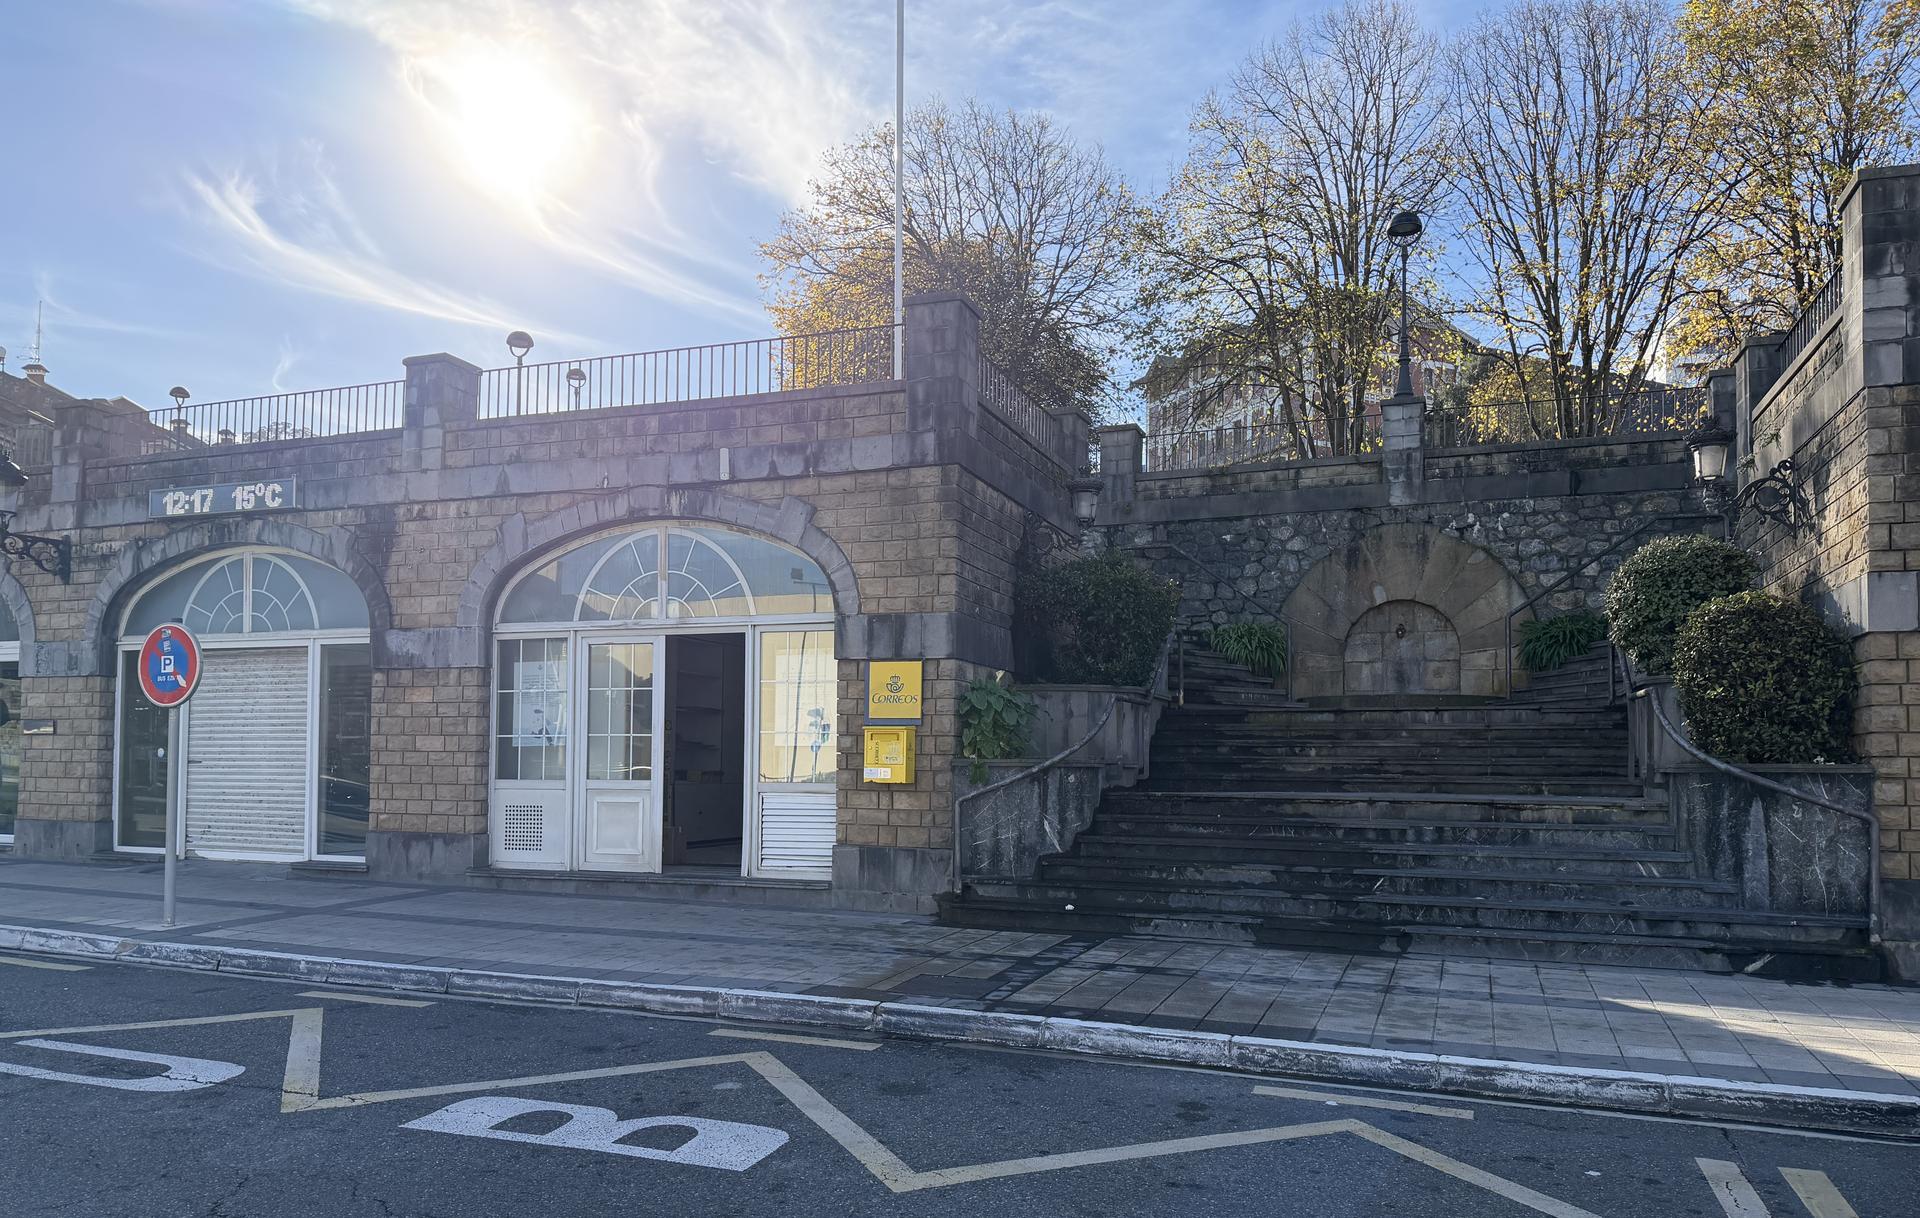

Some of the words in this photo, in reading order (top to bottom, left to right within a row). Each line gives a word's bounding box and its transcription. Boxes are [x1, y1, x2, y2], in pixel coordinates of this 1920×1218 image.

[162, 488, 214, 515] 12:17
[163, 657, 173, 671] P
[872, 692, 919, 704] CORREOS
